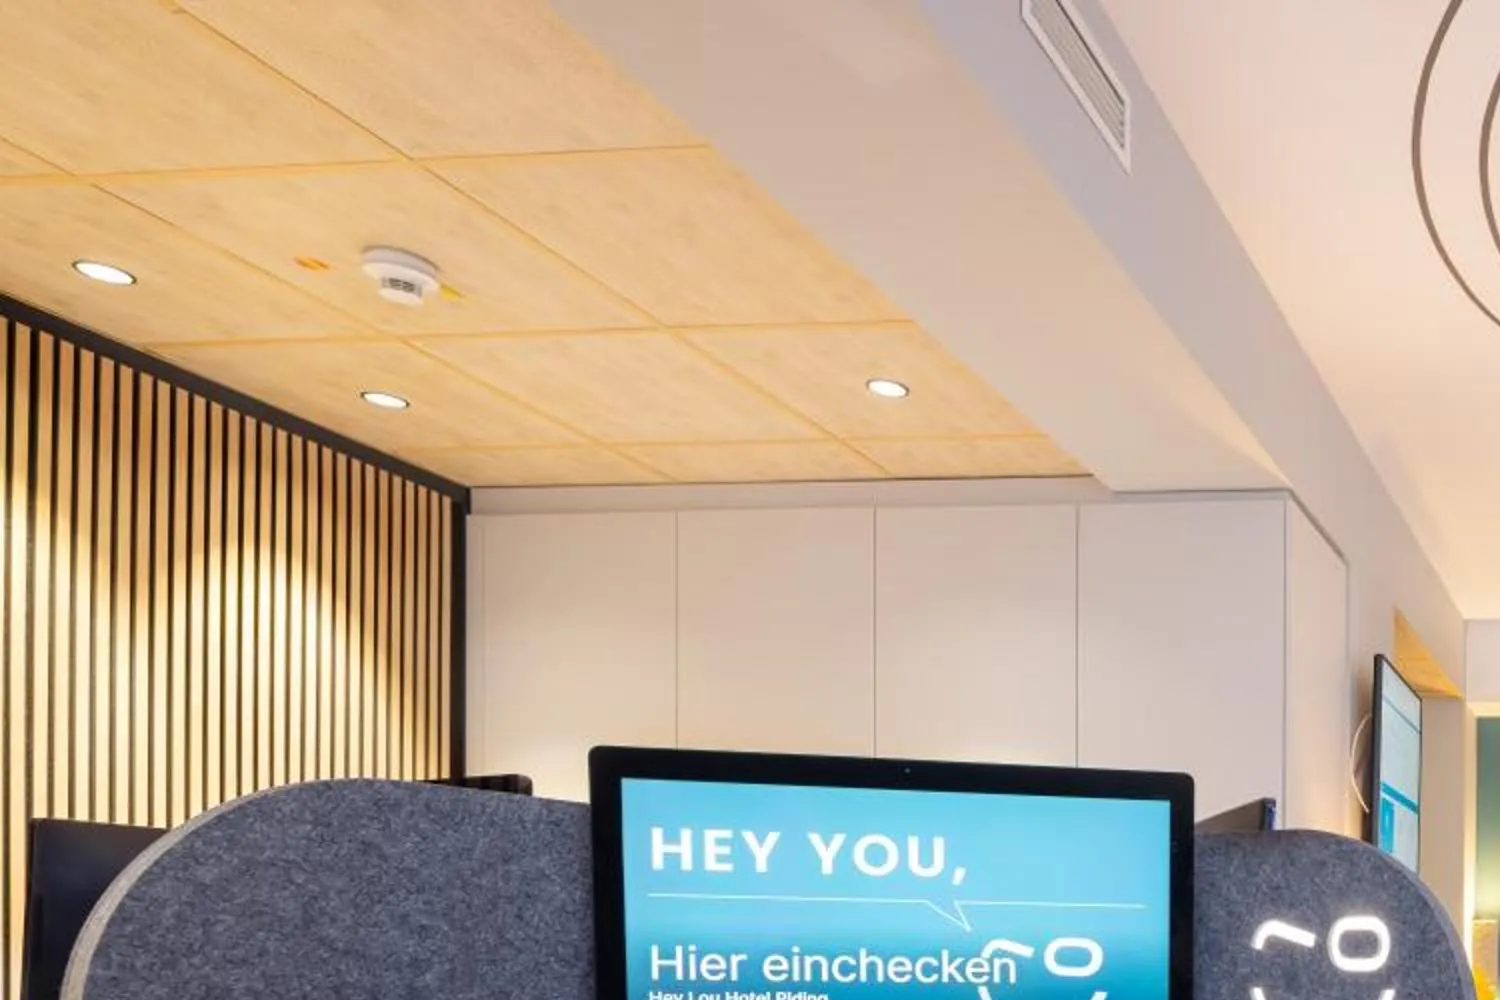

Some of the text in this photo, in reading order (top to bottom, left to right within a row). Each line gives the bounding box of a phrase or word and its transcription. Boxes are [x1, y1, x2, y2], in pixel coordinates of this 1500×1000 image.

[651, 827, 967, 886] HEY YOU,
[650, 944, 1018, 985] Hier einchecken
